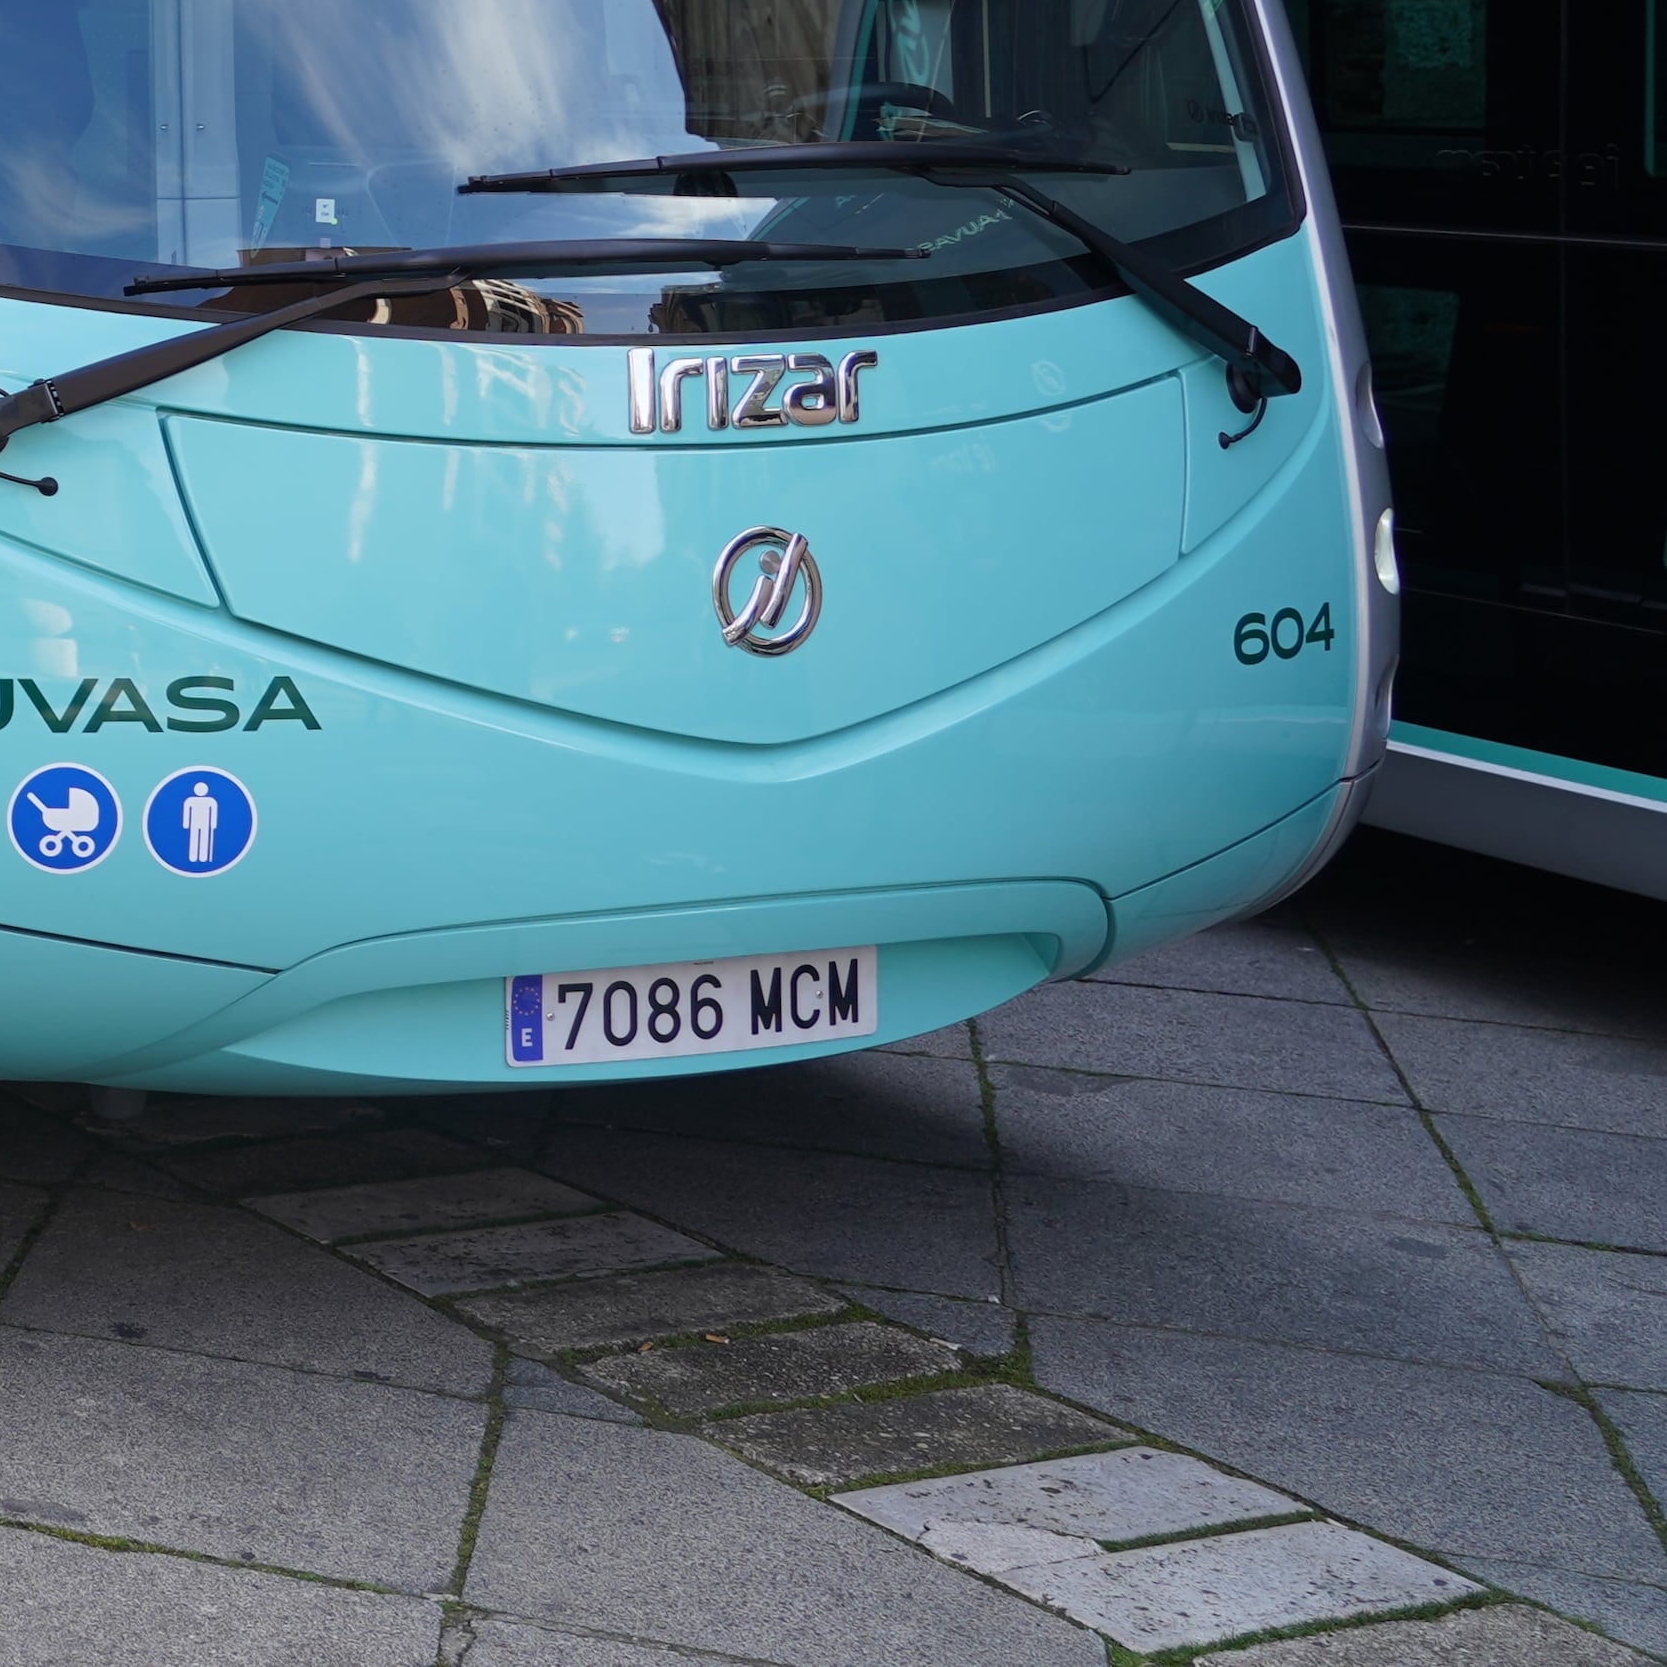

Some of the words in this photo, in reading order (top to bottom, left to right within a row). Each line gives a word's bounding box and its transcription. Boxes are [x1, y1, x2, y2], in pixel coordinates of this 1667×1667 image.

[626, 347, 879, 434] Irizar
[1233, 602, 1335, 666] 604
[521, 1027, 533, 1048] E
[557, 974, 723, 1051] 7086
[750, 958, 860, 1036] MCM
